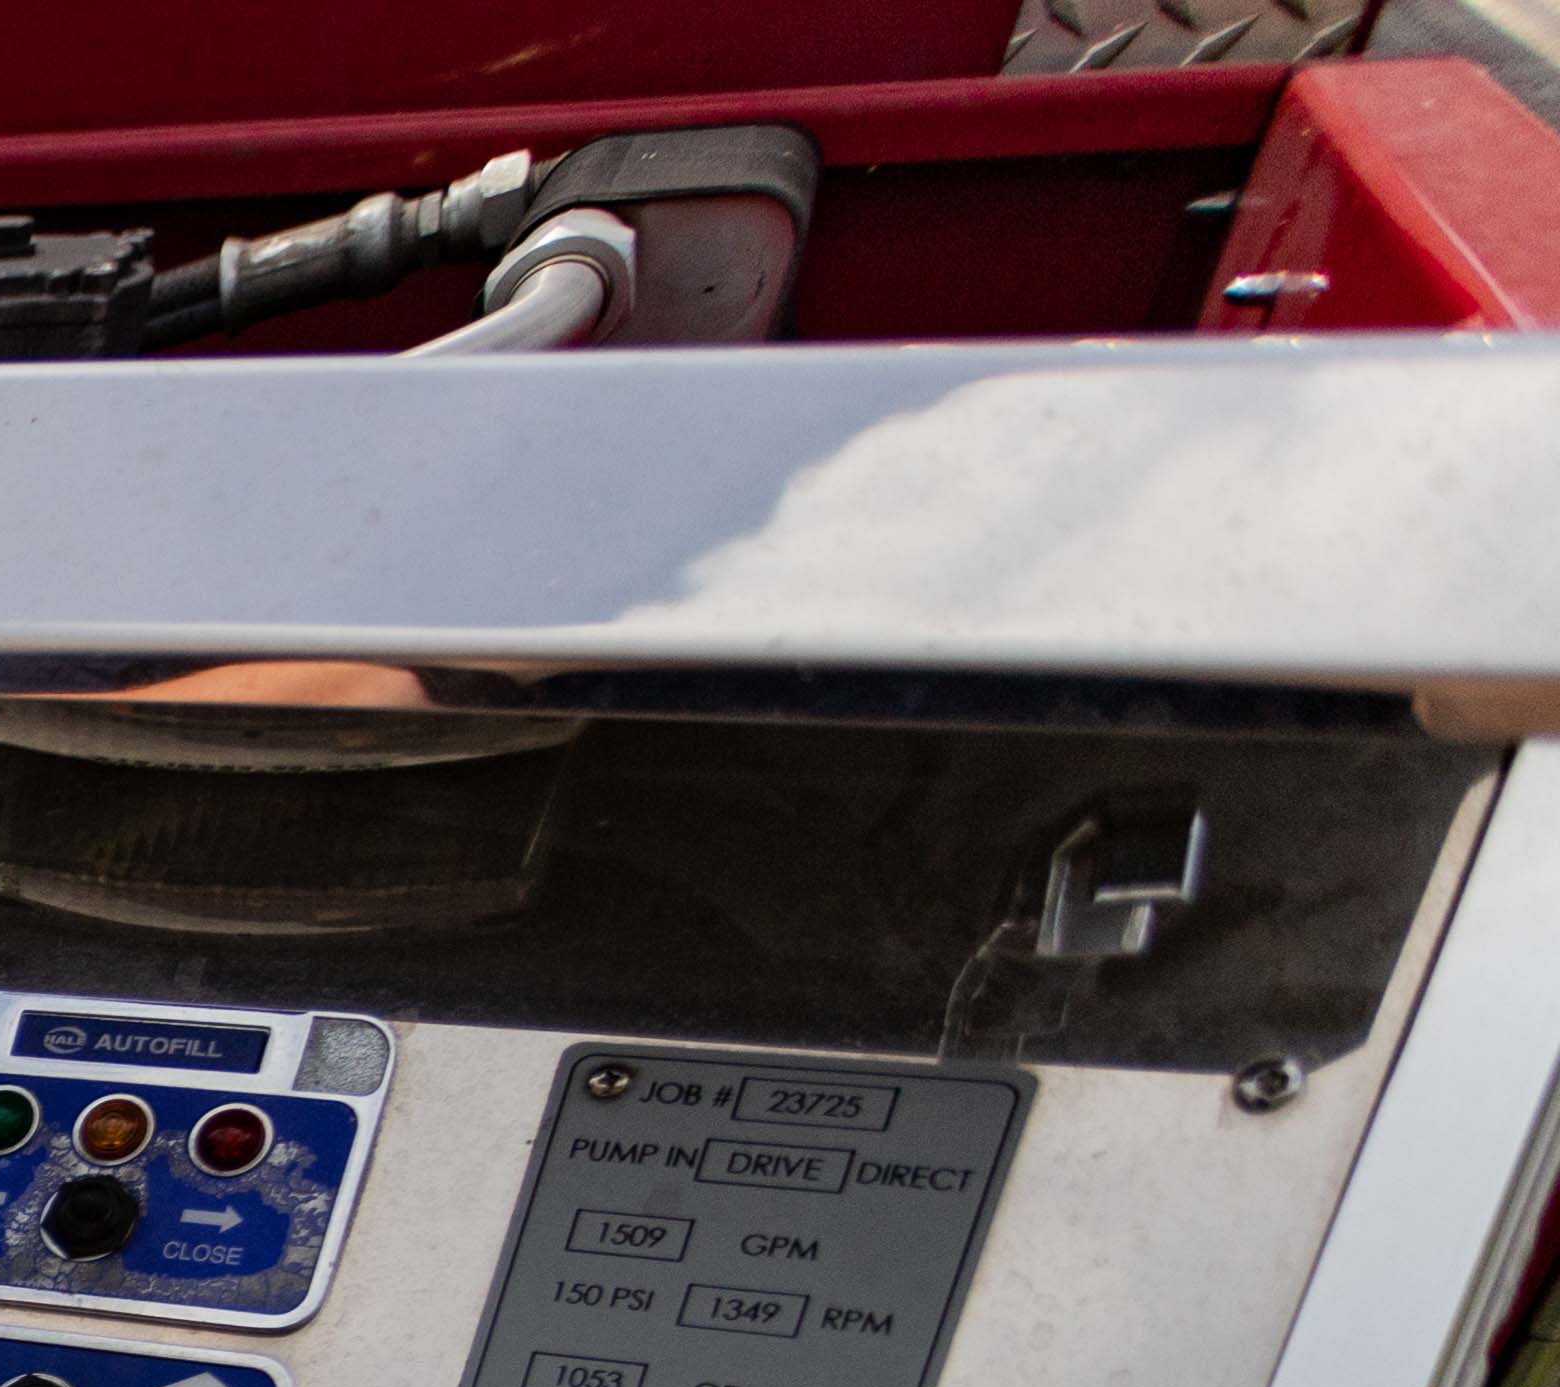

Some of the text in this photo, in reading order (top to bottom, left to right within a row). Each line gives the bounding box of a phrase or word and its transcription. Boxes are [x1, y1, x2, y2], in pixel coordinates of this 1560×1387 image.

[94, 1034, 222, 1059] AUTOFILL
[639, 1081, 861, 1118] JOB # 23725
[569, 1138, 975, 1193] PUMP IN DRIVE DIRECT
[163, 1241, 243, 1267] CLOSE
[598, 1221, 819, 1262] 1509 GPM
[553, 1280, 892, 1335] 150 PSI 1349 RPM
